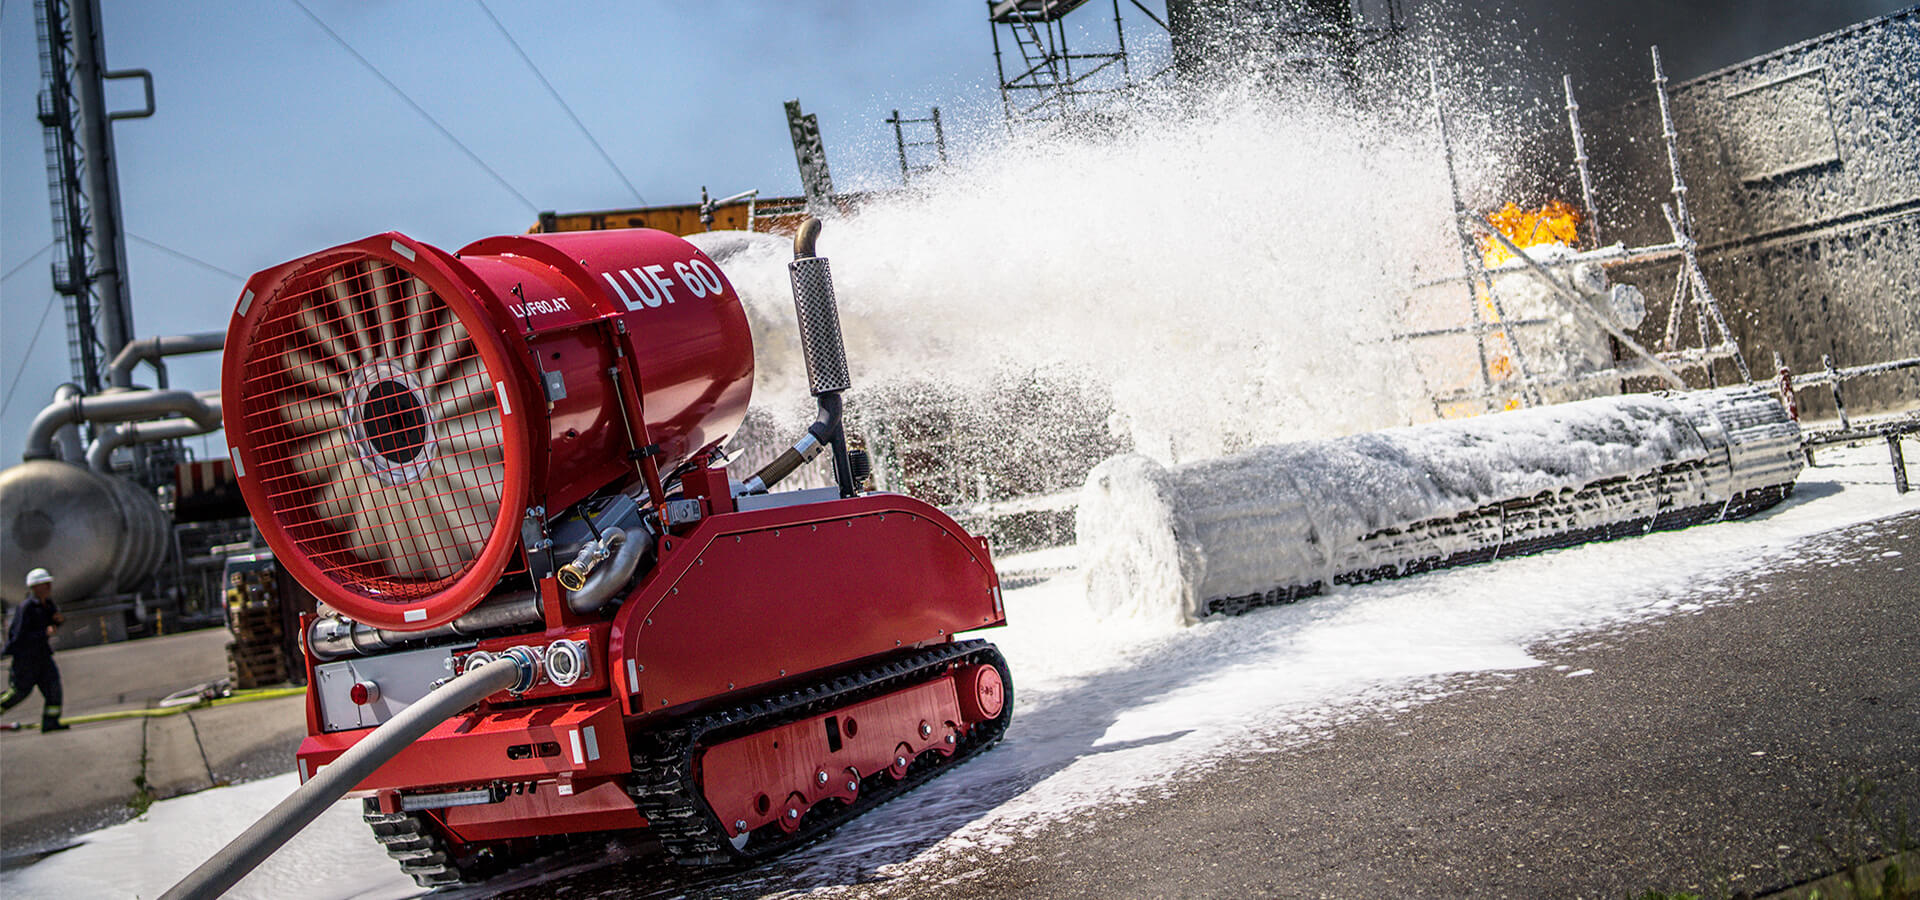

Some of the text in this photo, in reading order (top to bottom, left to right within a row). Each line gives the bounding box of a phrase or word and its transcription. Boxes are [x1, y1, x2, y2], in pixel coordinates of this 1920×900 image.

[601, 259, 723, 312] LUF 60
[509, 297, 571, 318] LUF60.AT
